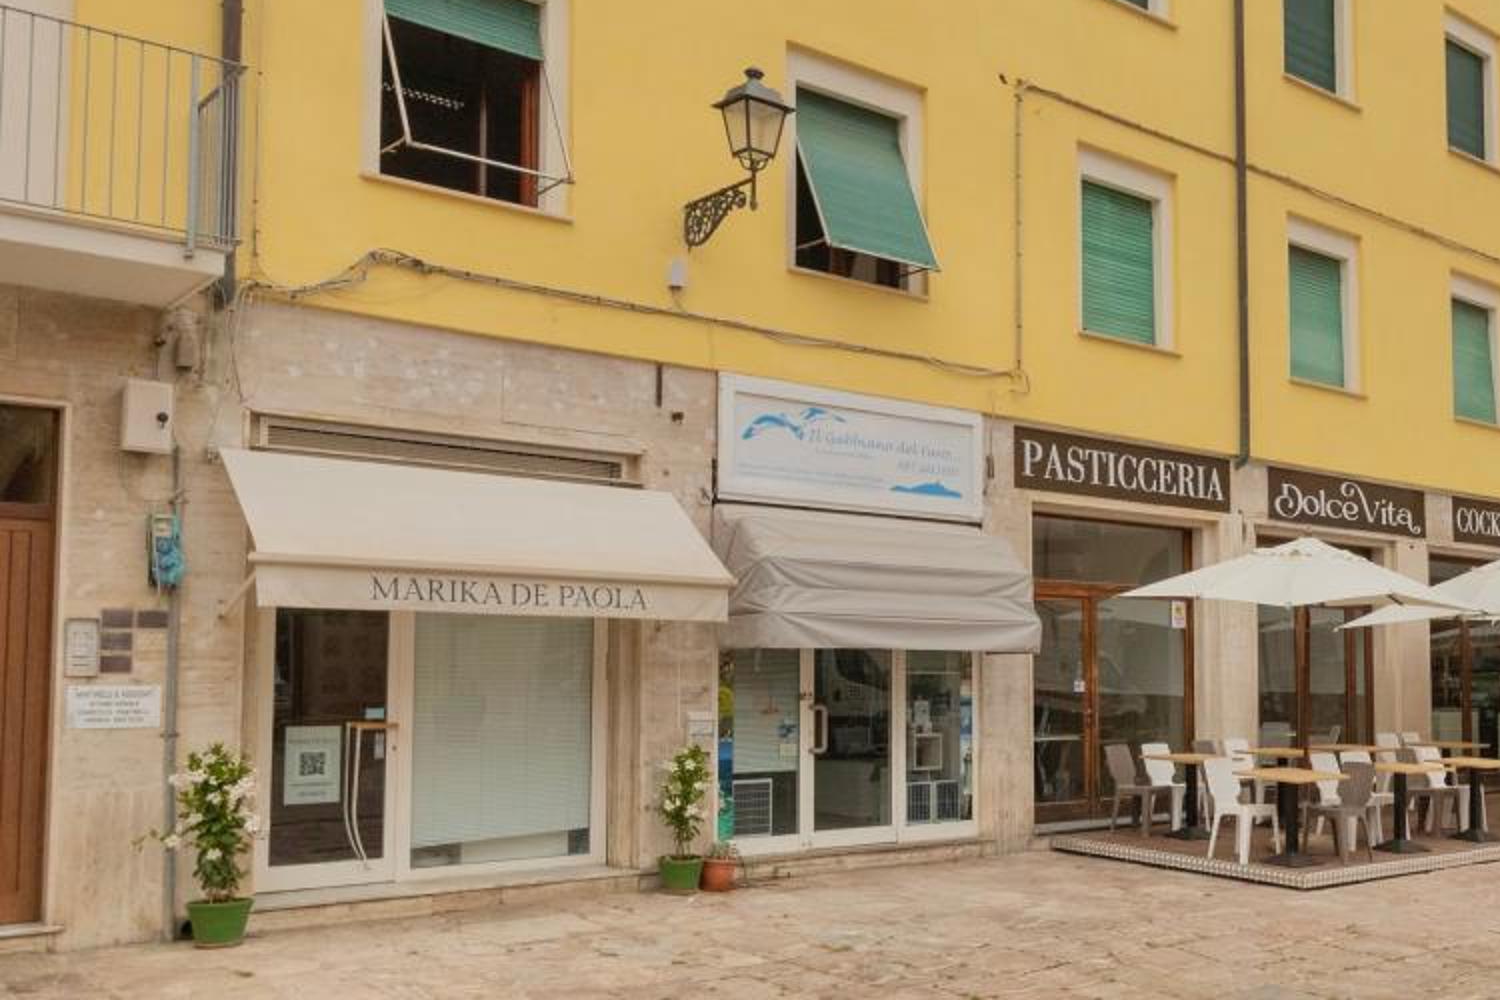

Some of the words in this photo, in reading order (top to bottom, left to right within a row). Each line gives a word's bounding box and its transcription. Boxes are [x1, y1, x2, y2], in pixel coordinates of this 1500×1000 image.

[1021, 439, 1224, 501] PASTICCERIA
[1274, 482, 1360, 521] Dolce
[1340, 481, 1421, 535] Vita
[371, 576, 503, 606] MARIKA
[511, 583, 549, 607] DE
[558, 584, 648, 611] PAOLA
